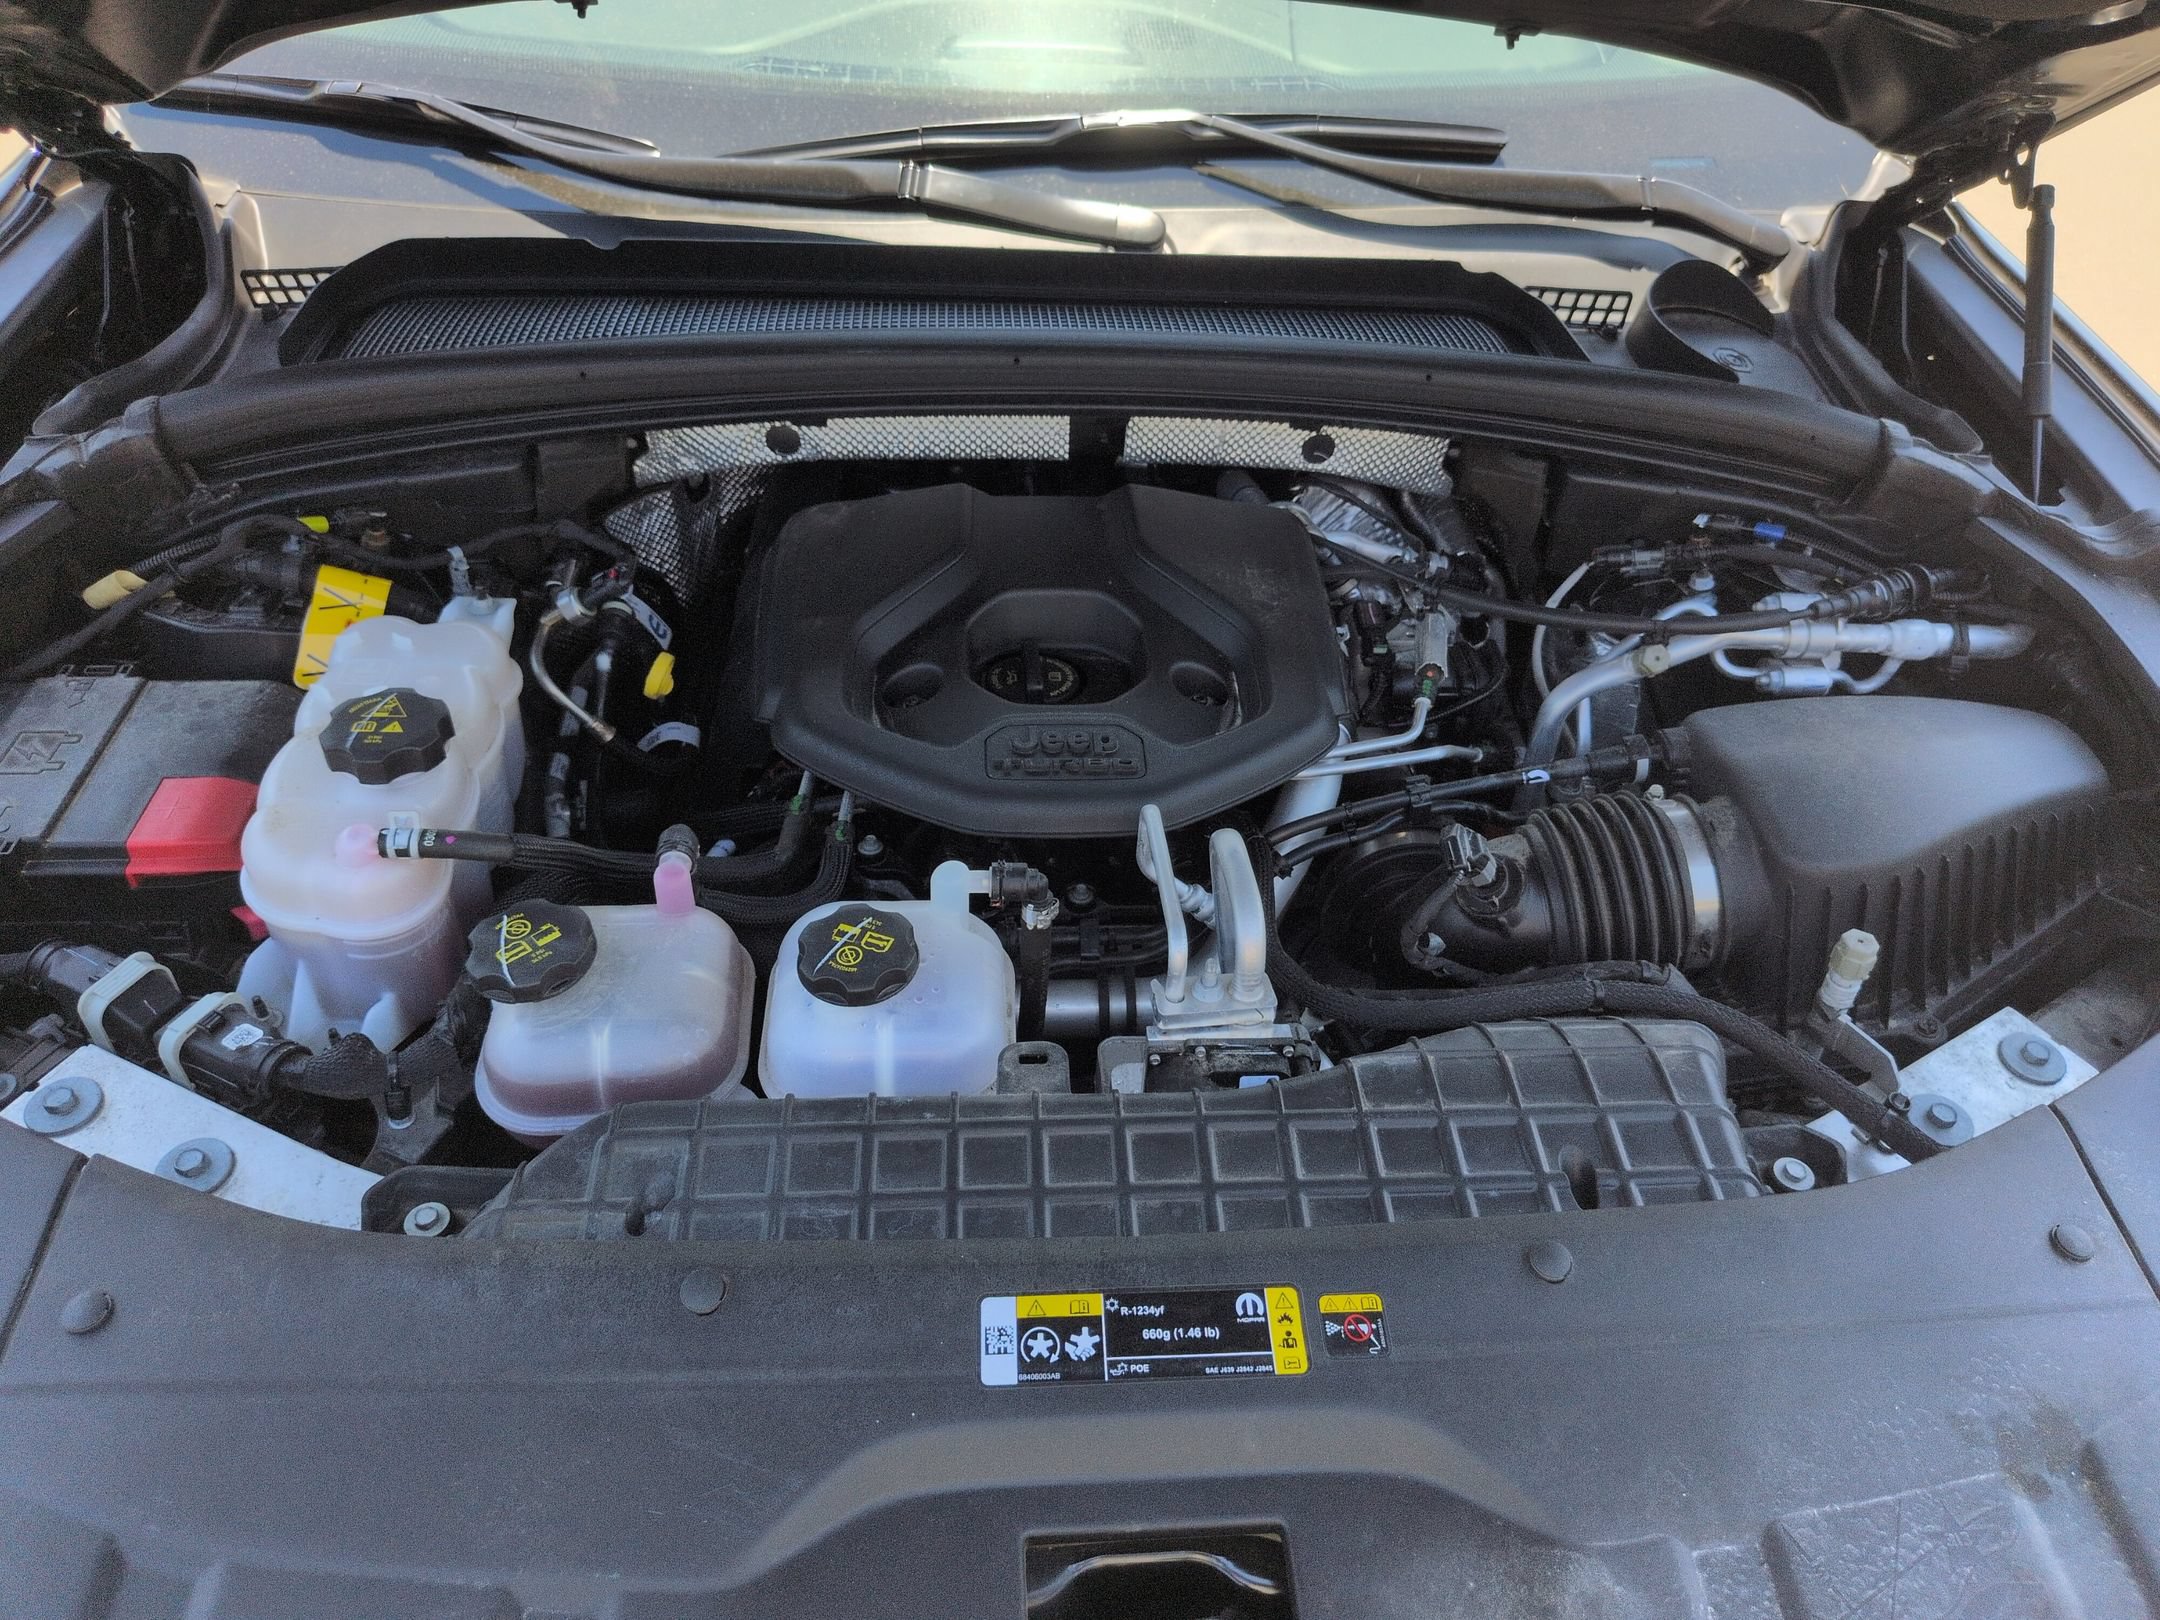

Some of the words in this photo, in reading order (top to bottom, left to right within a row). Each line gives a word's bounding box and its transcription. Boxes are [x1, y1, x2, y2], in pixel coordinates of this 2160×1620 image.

[1009, 726, 1119, 757] Jeep
[1120, 1305, 1164, 1317] R-1234yf
[1142, 1328, 1171, 1342] 660g
[1173, 1327, 1202, 1341] (1.46
[1204, 1326, 1220, 1340] lb)
[1130, 1364, 1150, 1373] POE
